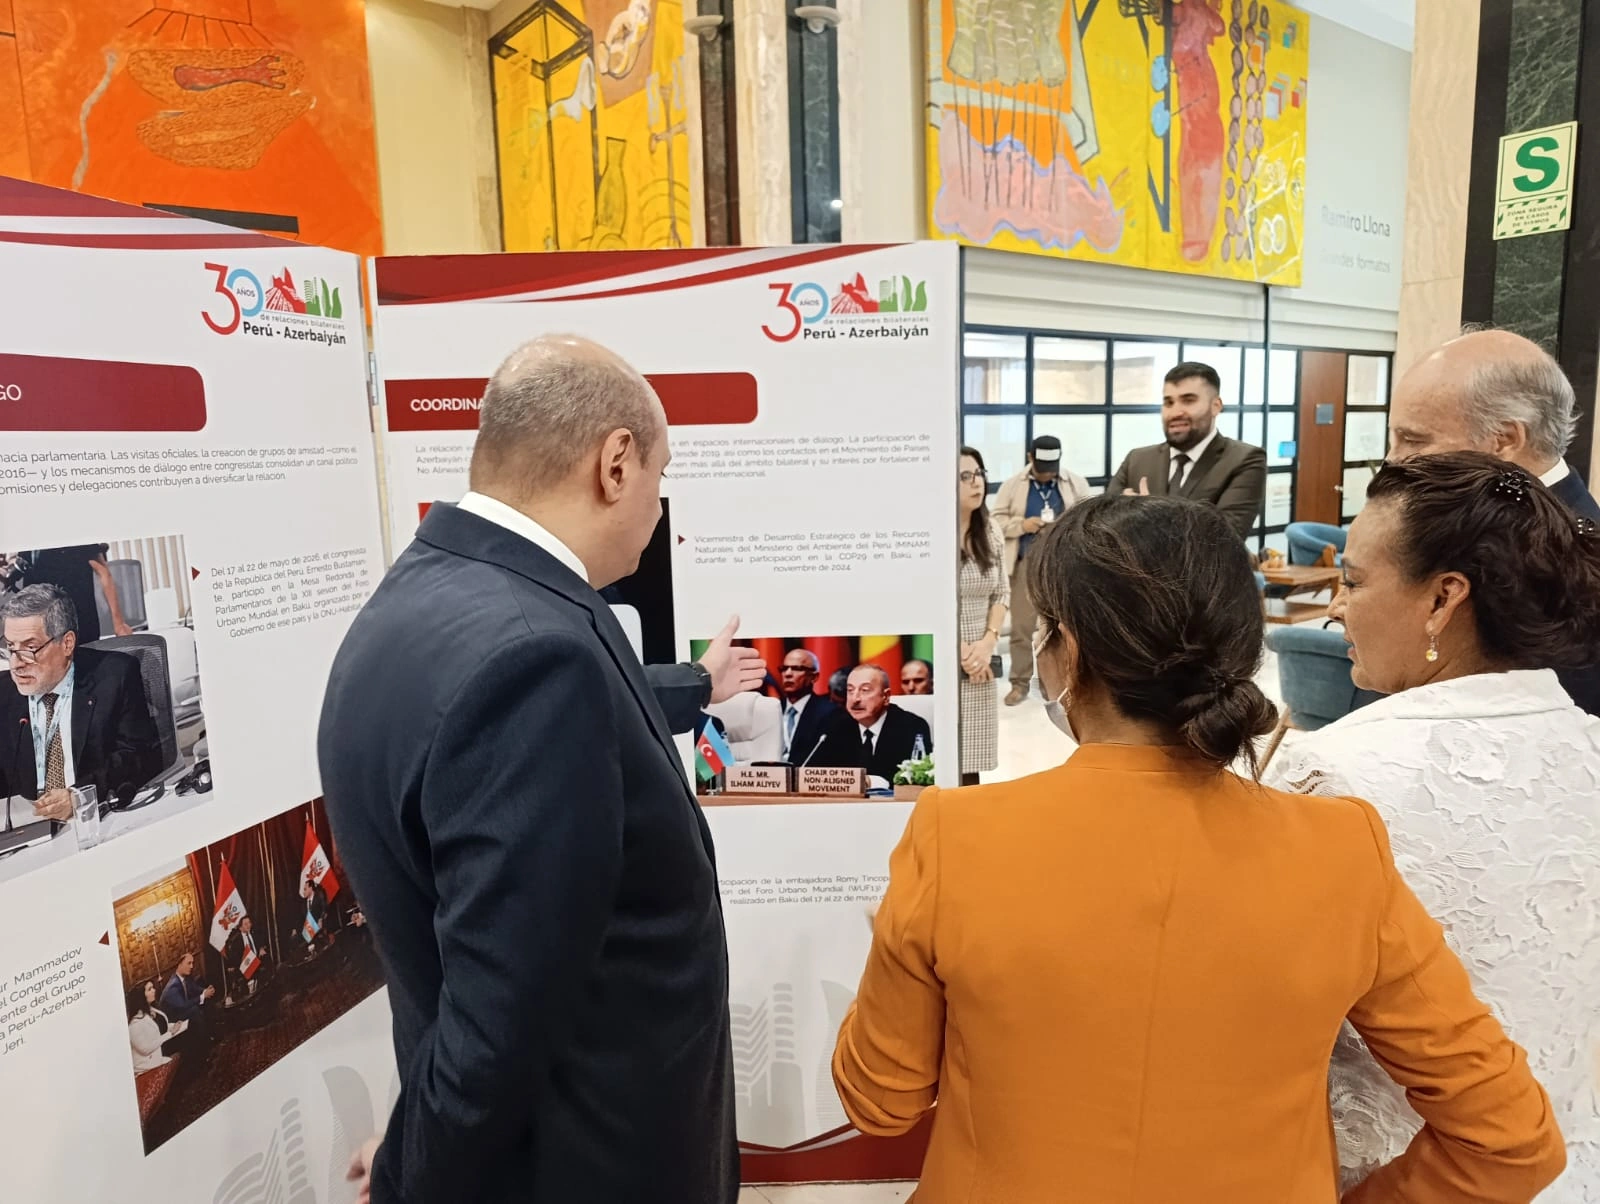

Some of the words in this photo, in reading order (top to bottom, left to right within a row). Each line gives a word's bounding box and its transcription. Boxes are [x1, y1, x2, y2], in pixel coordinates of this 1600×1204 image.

[1512, 136, 1560, 192] S
[1321, 205, 1360, 231] Ramiro
[1363, 215, 1390, 237] Llona
[201, 262, 264, 336] 30
[236, 286, 256, 298] AÑOS
[271, 315, 309, 326] relaciones
[761, 282, 829, 342] 30
[836, 316, 880, 325] relaciones
[243, 321, 273, 338] Perú
[284, 326, 346, 347] Azerbaiyán
[804, 326, 836, 340] Perú
[848, 325, 929, 340] Azerbaiyán
[110, 450, 129, 460] Las
[130, 450, 160, 460] visitas
[202, 448, 210, 458] la
[248, 447, 258, 457] de
[259, 448, 286, 460] grupos
[287, 446, 296, 456] de
[40, 469, 48, 480] y
[51, 466, 68, 477] los
[70, 464, 136, 476] mecanismos
[138, 463, 151, 474] de
[189, 462, 212, 472] entre
[214, 460, 264, 473] congresistas
[266, 458, 304, 469] consolidan
[60, 484, 66, 495] y
[68, 478, 138, 493] delegaciones
[139, 476, 194, 488] contribuyen
[194, 477, 200, 485] a
[202, 472, 246, 484] diversificar
[246, 472, 254, 482] la
[211, 568, 226, 578] Del
[227, 566, 236, 576] 17
[238, 563, 246, 573] al
[246, 564, 256, 572] 22
[258, 560, 268, 570] de
[270, 560, 290, 570] mayo
[292, 557, 302, 566] de
[212, 580, 224, 590] de
[225, 579, 234, 588] la
[274, 570, 286, 579] del
[271, 584, 282, 592] en
[288, 581, 295, 590] la
[300, 578, 320, 586] Mesa
[215, 598, 272, 616] Parlamentarios
[276, 594, 287, 604] de
[216, 614, 246, 628] Urbano
[248, 607, 279, 622] Mundial
[280, 606, 290, 615] en
[230, 624, 264, 638] Gobierno
[266, 621, 276, 630] de
[730, 780, 754, 788] ILHAM
[756, 780, 781, 788] ALIYEV
[756, 886, 774, 895] Foro
[778, 886, 808, 894] Urbano
[812, 884, 844, 894] Mundial
[760, 878, 772, 886] de
[786, 876, 832, 886] embajadora
[836, 875, 858, 884] Romy
[14, 947, 82, 986] Mammadov
[10, 970, 66, 1004] Congreso
[68, 961, 84, 974] de
[30, 992, 50, 1008] del
[50, 975, 86, 998] Grupo
